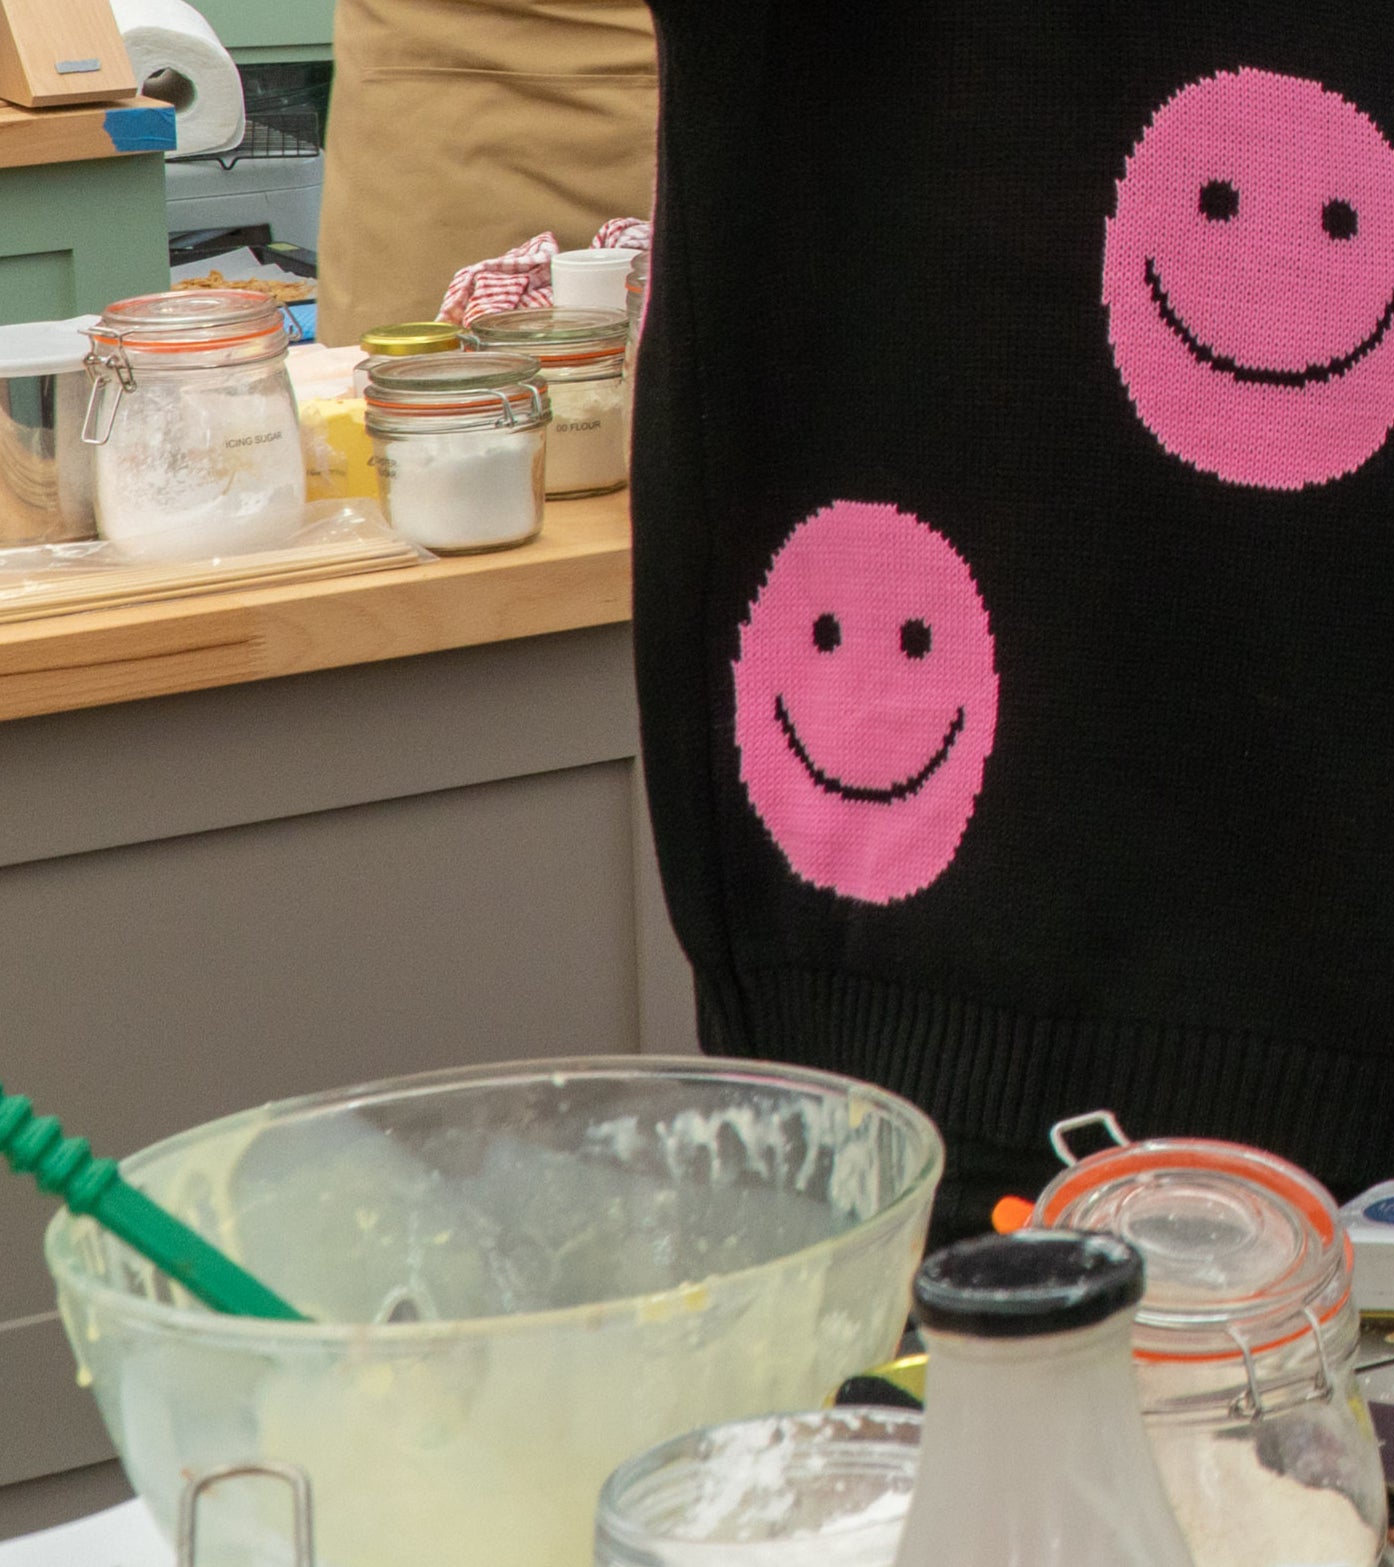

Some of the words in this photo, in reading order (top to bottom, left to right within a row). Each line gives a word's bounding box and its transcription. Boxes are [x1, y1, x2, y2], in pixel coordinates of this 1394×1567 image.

[570, 419, 601, 431] FLOUR
[225, 436, 253, 448] ICING
[254, 431, 283, 444] SUGAR
